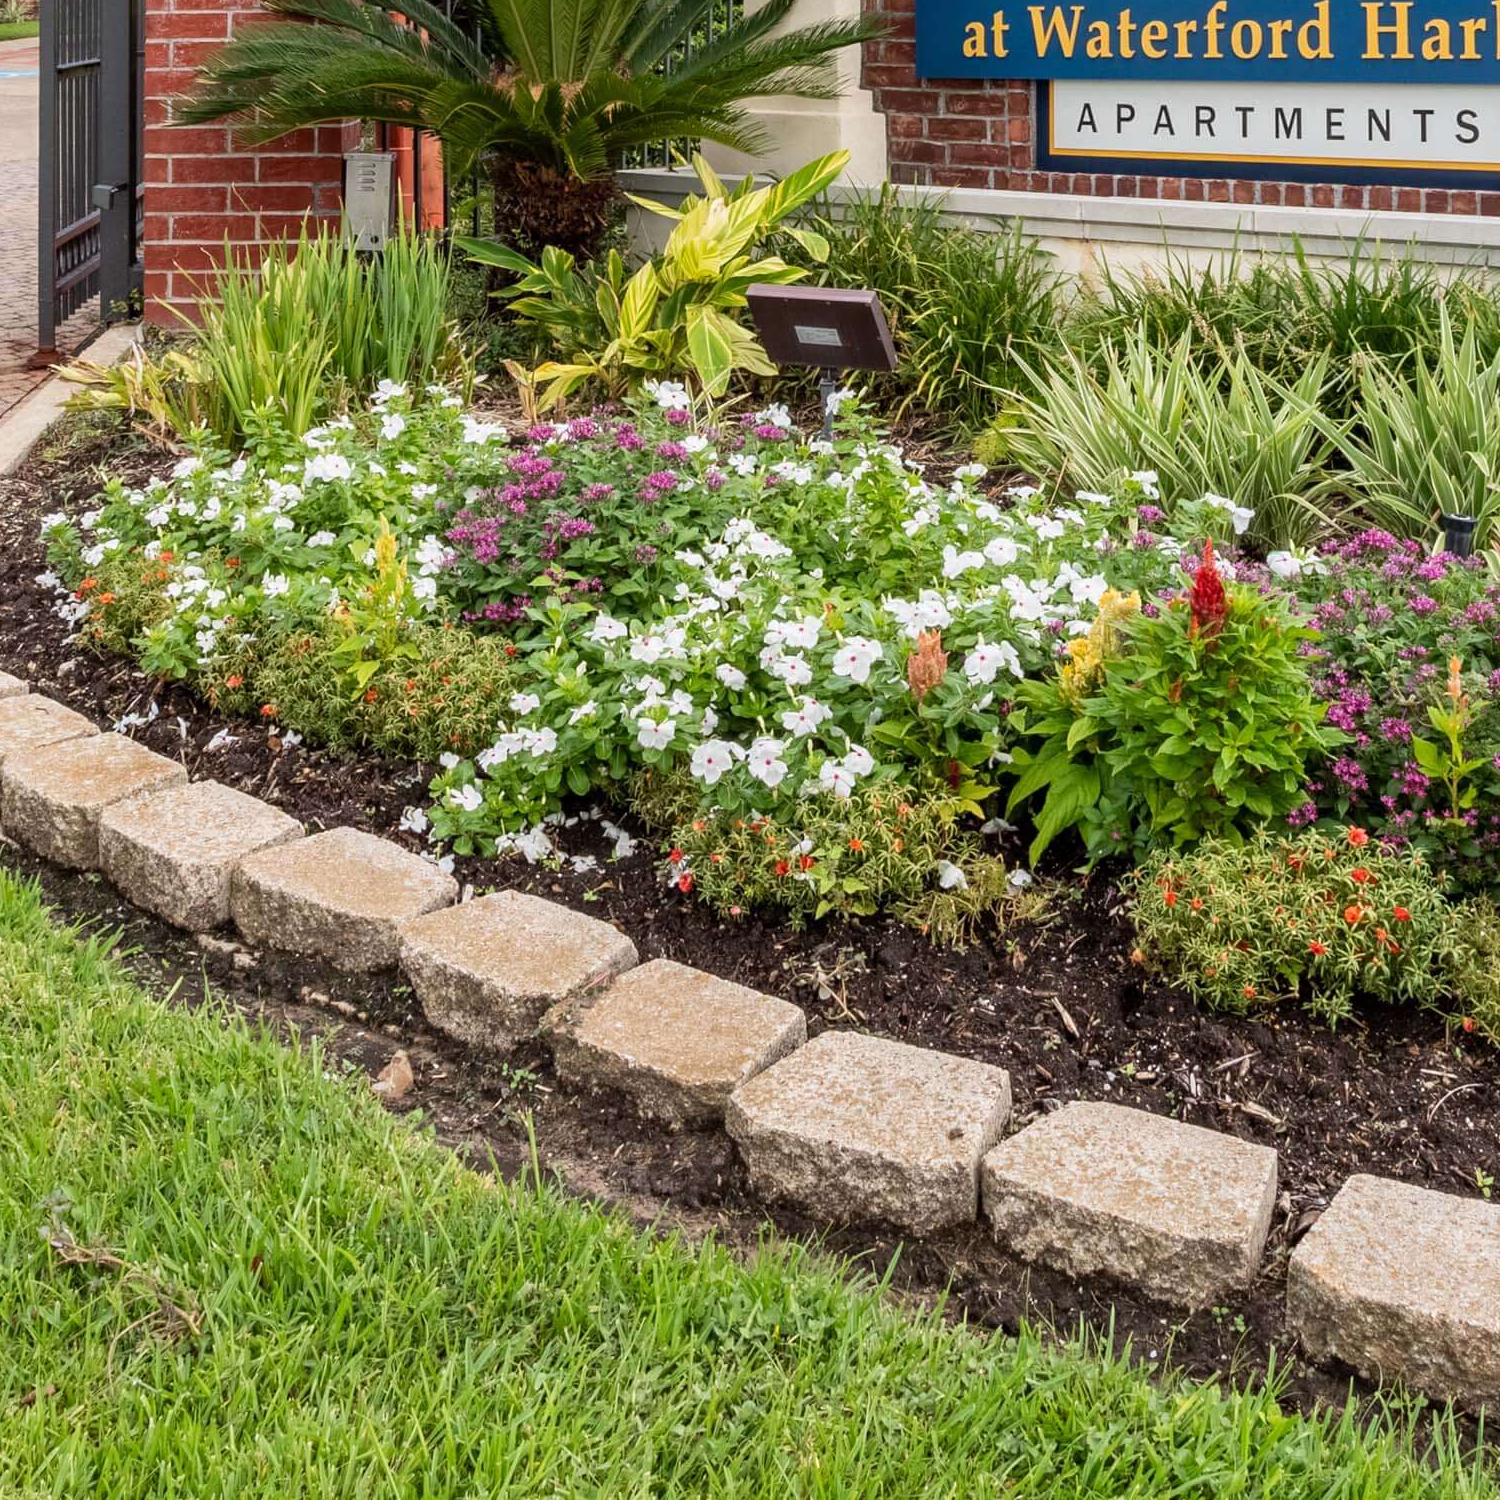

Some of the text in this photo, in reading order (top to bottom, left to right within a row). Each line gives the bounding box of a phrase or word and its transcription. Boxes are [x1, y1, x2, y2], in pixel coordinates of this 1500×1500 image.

[962, 11, 1008, 58] at
[1027, 0, 1333, 60] Waterford
[1076, 102, 1480, 144] APARTMENTS
